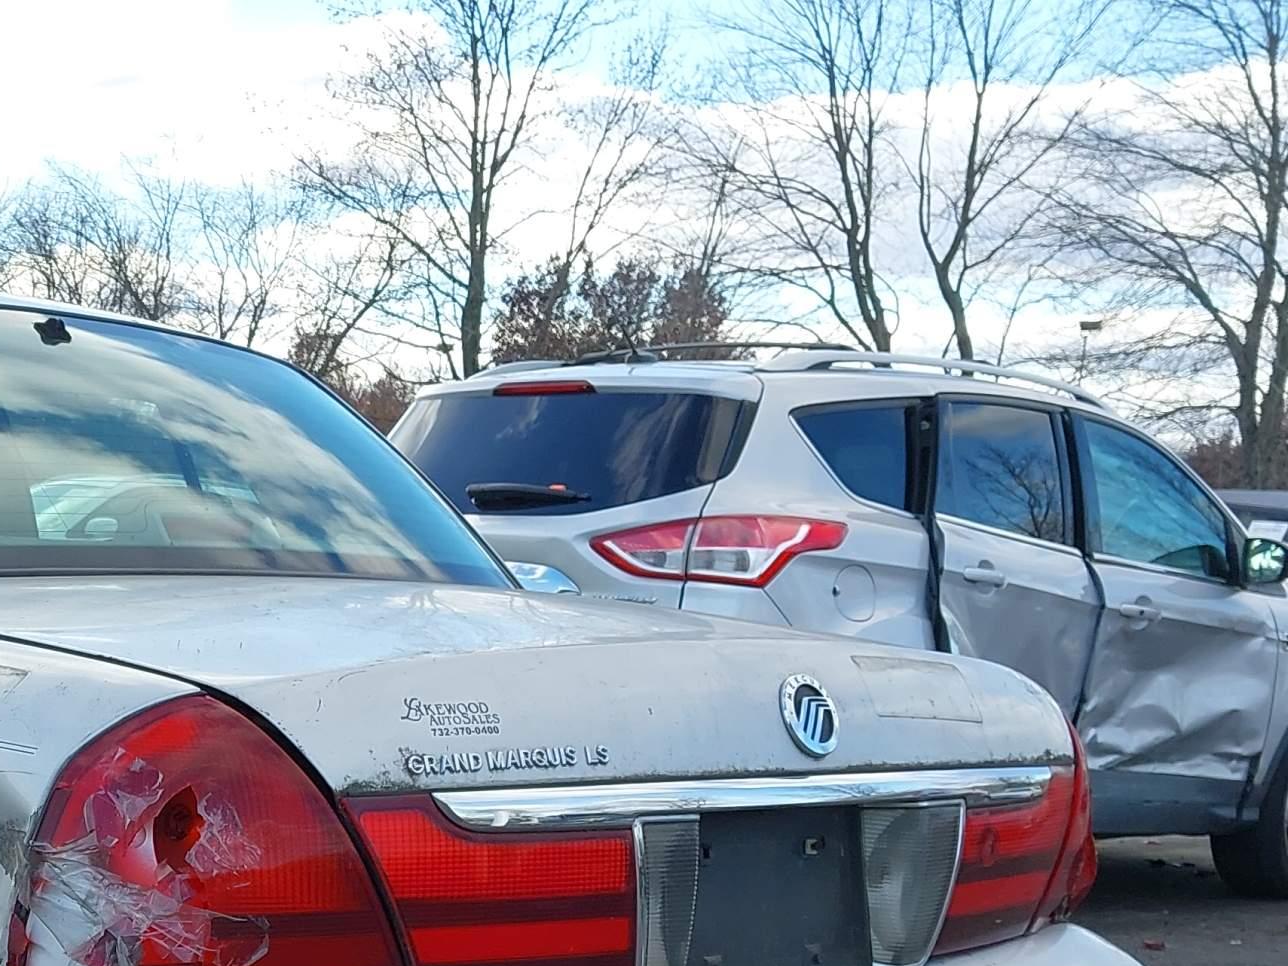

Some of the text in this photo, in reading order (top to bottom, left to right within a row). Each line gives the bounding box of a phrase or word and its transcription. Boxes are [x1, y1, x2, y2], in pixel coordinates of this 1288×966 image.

[430, 726, 500, 737] 732-370-0400
[406, 743, 610, 776] GRAND MARQUIS LS
